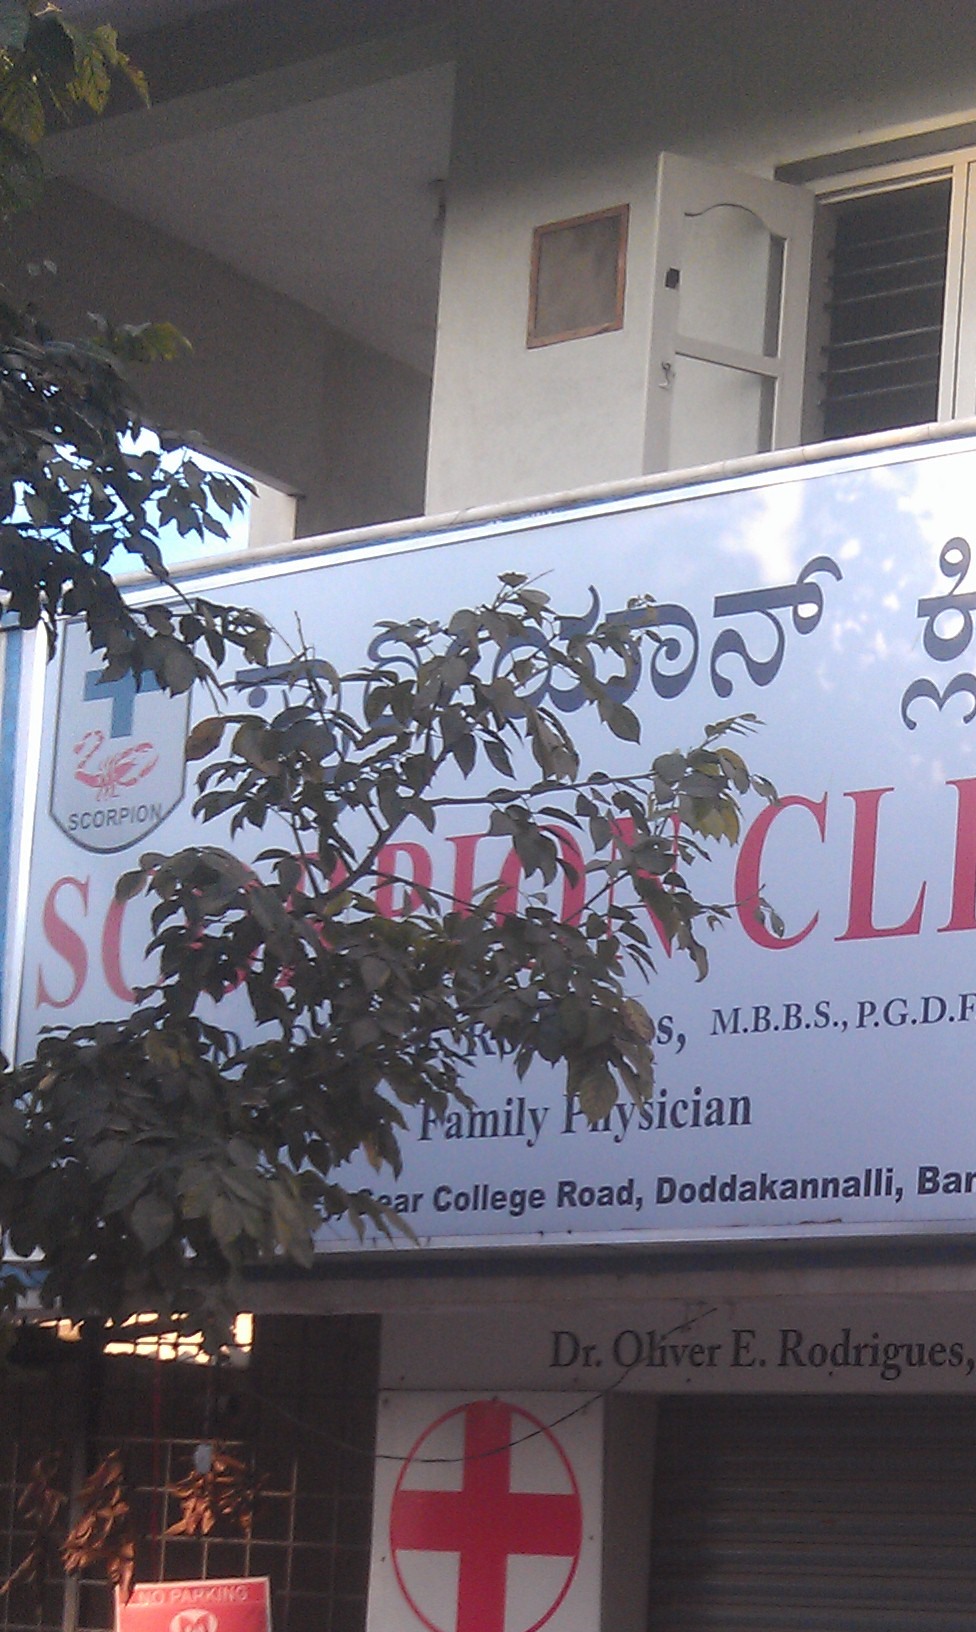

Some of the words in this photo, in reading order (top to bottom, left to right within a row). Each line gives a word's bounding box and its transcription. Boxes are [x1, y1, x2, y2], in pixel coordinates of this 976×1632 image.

[68, 802, 162, 831] SCORPION
[418, 1096, 550, 1148] Family
[433, 1184, 546, 1217] College
[557, 1178, 643, 1212] Road,
[656, 1167, 904, 1205] Doddakannalli,
[549, 1329, 601, 1367] Dr.
[613, 1329, 721, 1367] Oliver
[730, 1328, 767, 1367] E.
[778, 1327, 975, 1380] Rodrigues,
